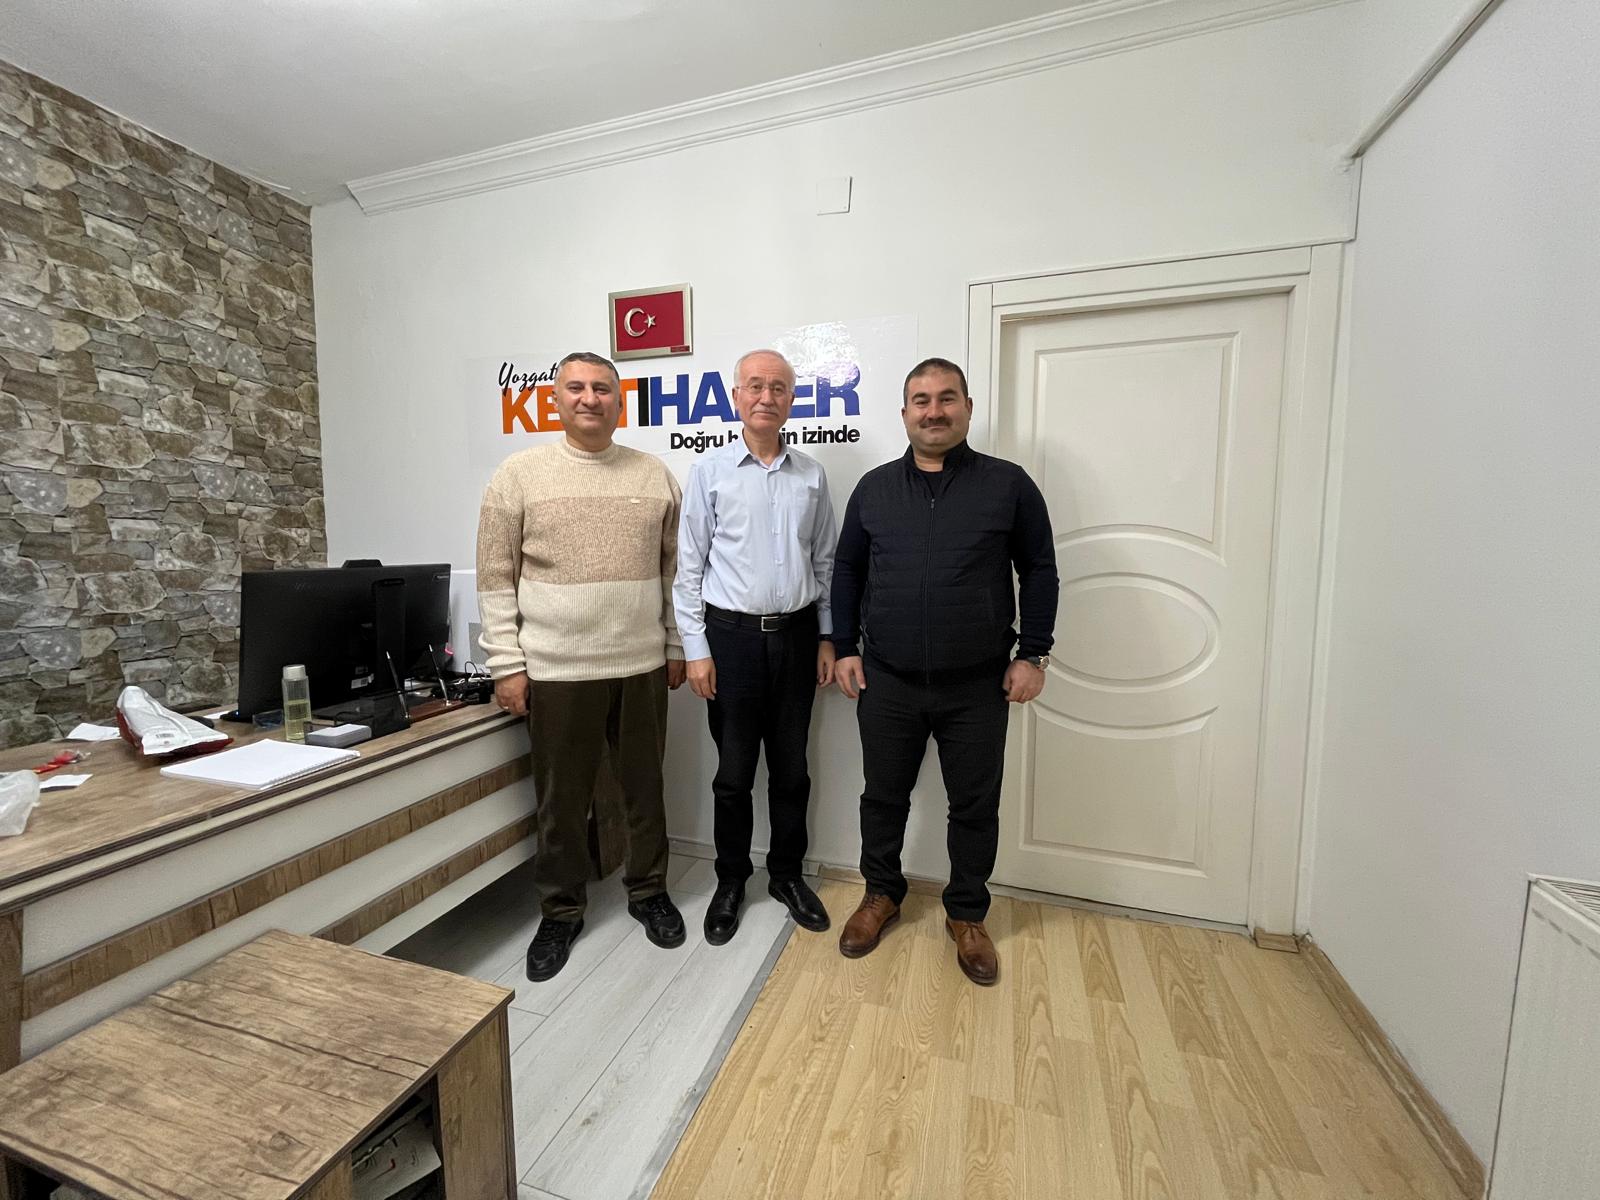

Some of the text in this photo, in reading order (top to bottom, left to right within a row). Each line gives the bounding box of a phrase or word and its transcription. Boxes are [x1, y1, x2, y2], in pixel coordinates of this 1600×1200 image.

[498, 361, 558, 397] Yozgat
[670, 430, 724, 454] Doğru
[802, 424, 861, 445] izinde
